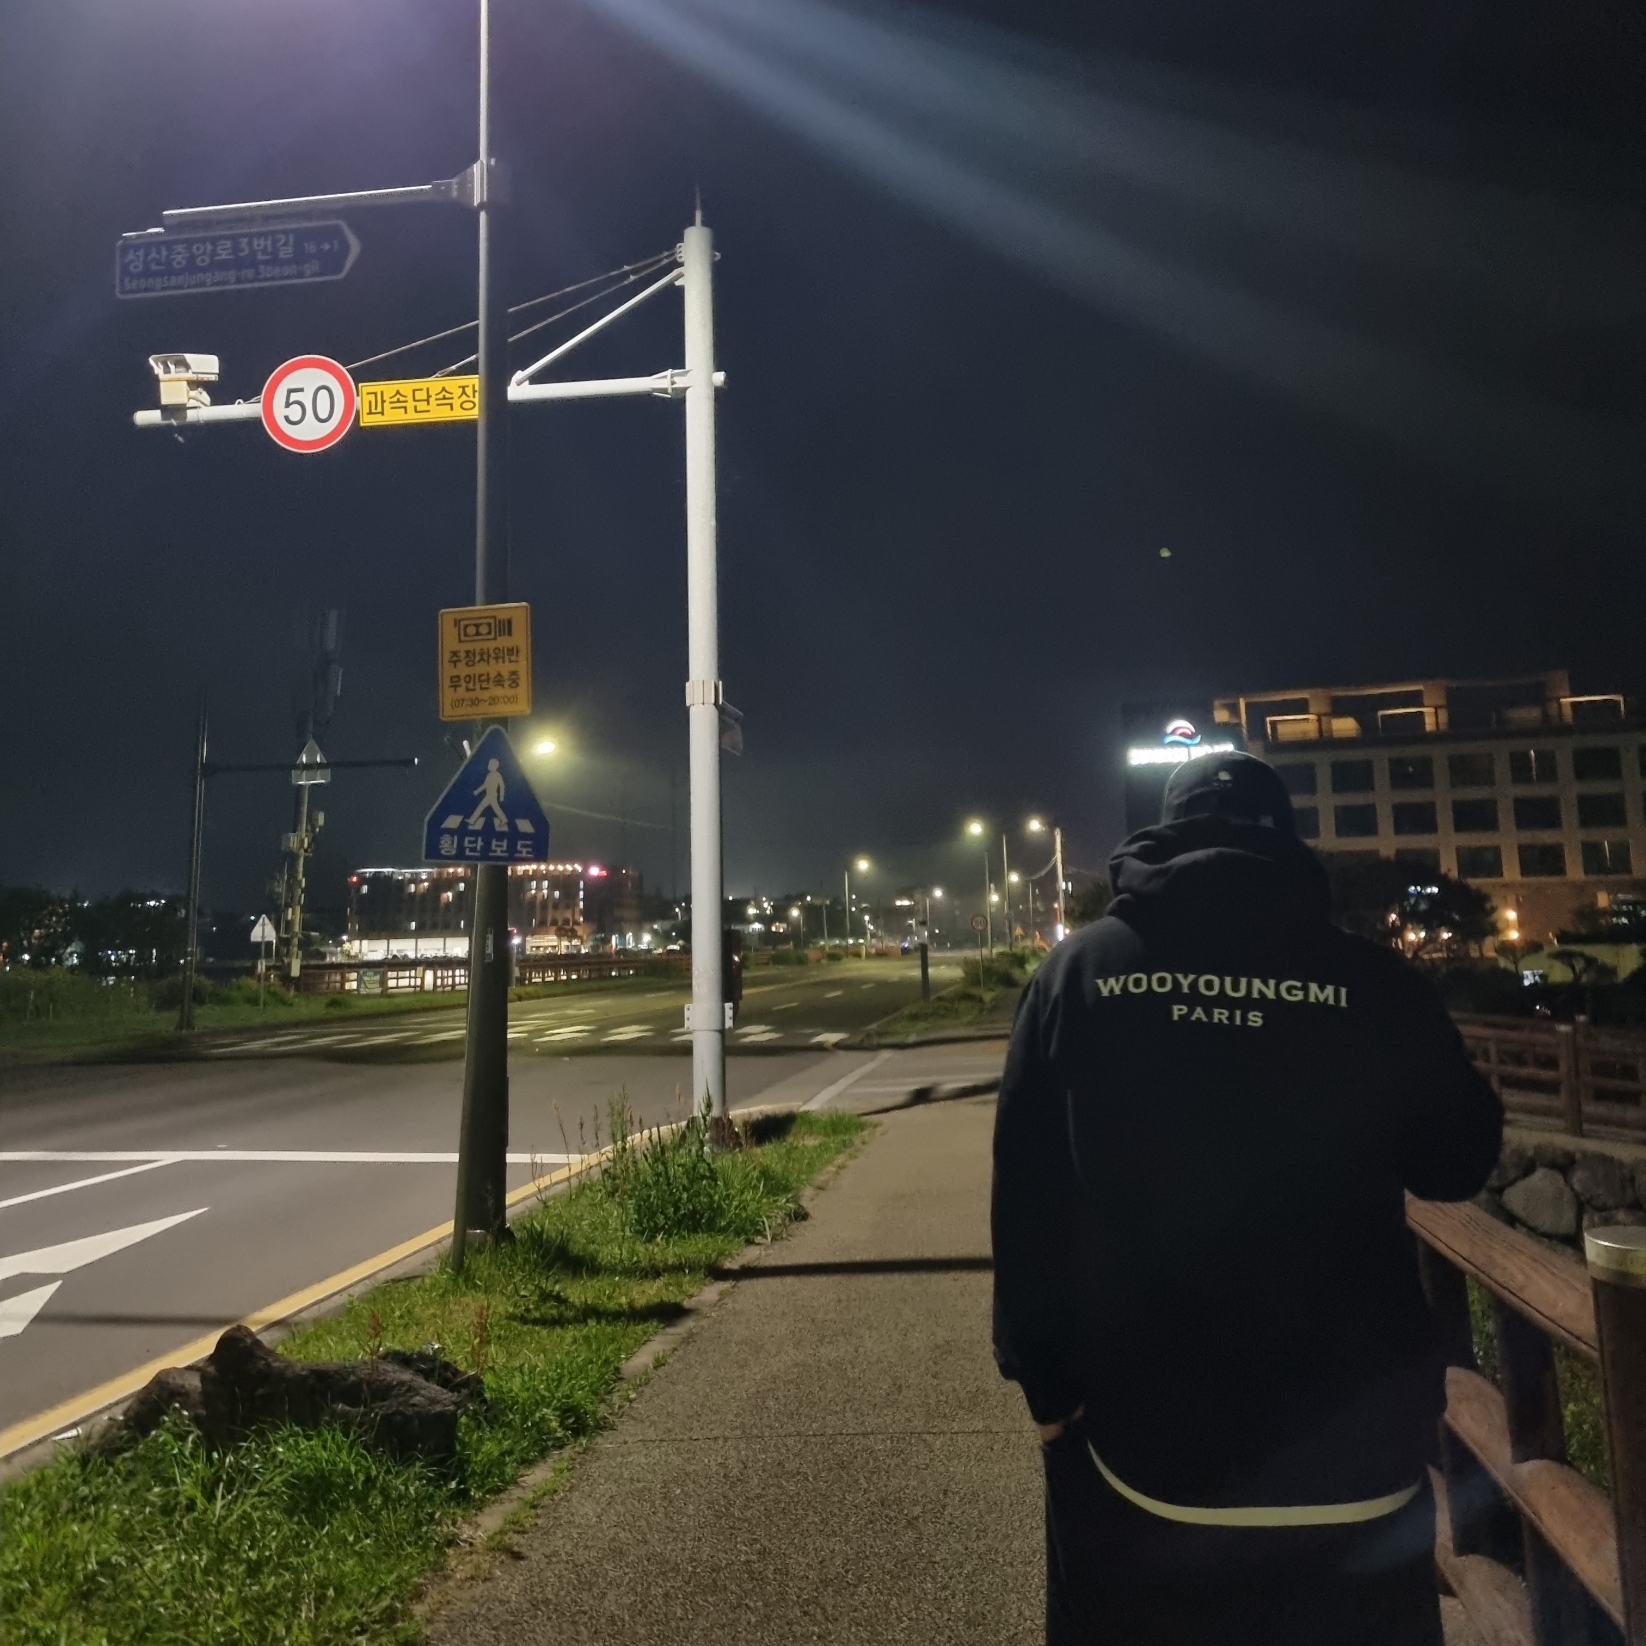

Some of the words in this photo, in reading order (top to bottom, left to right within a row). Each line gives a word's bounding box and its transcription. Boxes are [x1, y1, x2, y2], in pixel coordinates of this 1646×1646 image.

[123, 233, 295, 273] 성산중앙로3번길
[283, 385, 335, 426] 50
[365, 384, 478, 417] 과속단속장
[448, 645, 520, 668] 주정차위반
[448, 670, 520, 693] 무인단속중
[439, 834, 534, 858] 횡단보도
[1094, 971, 1349, 1008] WOOYOUNGMI
[1171, 1004, 1264, 1027] PARIS
